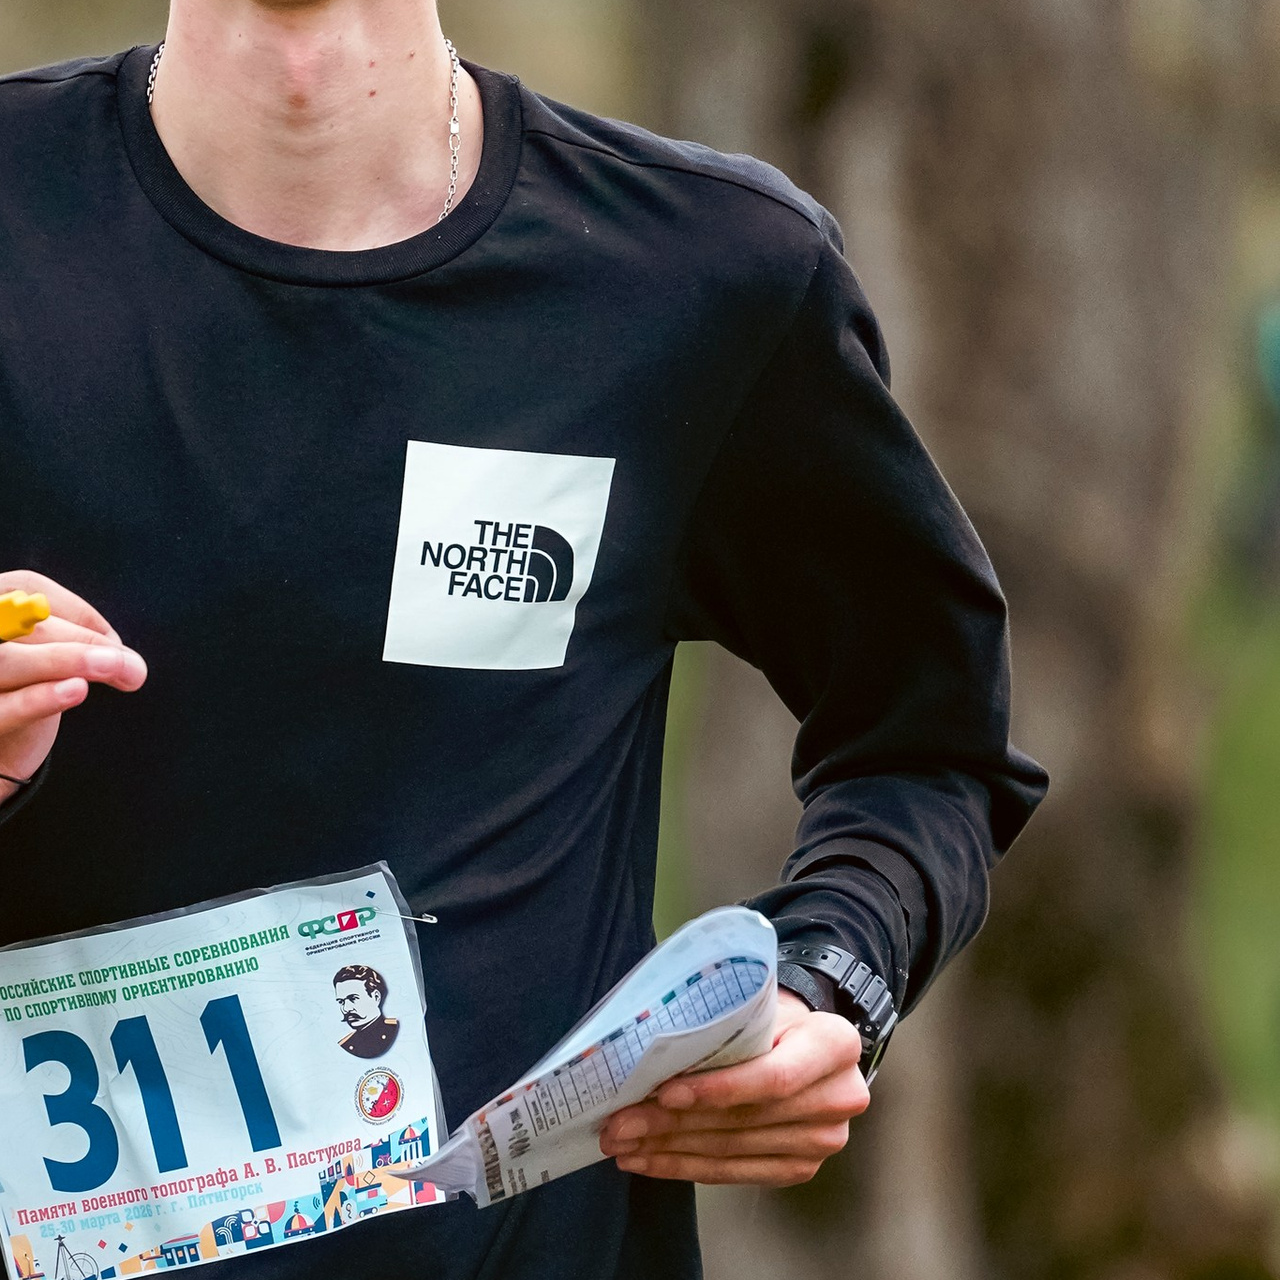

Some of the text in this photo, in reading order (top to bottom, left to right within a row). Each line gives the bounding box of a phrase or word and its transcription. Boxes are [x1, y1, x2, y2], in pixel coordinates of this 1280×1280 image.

[474, 520, 532, 549] THE
[420, 541, 528, 575] NORTH
[448, 571, 523, 602] FACE
[78, 955, 171, 986] СПОРТИВНЫЕ
[173, 924, 291, 967] СОРЕВНОВАНИЯ
[304, 928, 380, 952] ФЕДЕРАЦИЯ СПОРТИВНОГО
[306, 934, 381, 956] ОРИЕНТИРОВАНИЯ РОССИИ
[3, 956, 259, 1022] ПО СПОРТИВНОМУ ОРИЕНТИРОВАНИЮ
[22, 993, 283, 1193] 311
[16, 1137, 362, 1226] Памяти военного топографа А. В. Пастухова
[39, 1220, 75, 1238] 25-30
[80, 1211, 121, 1231] марта
[124, 1203, 153, 1222] 2026
[154, 1204, 167, 1216] г.
[187, 1181, 264, 1209] Пятигорск
